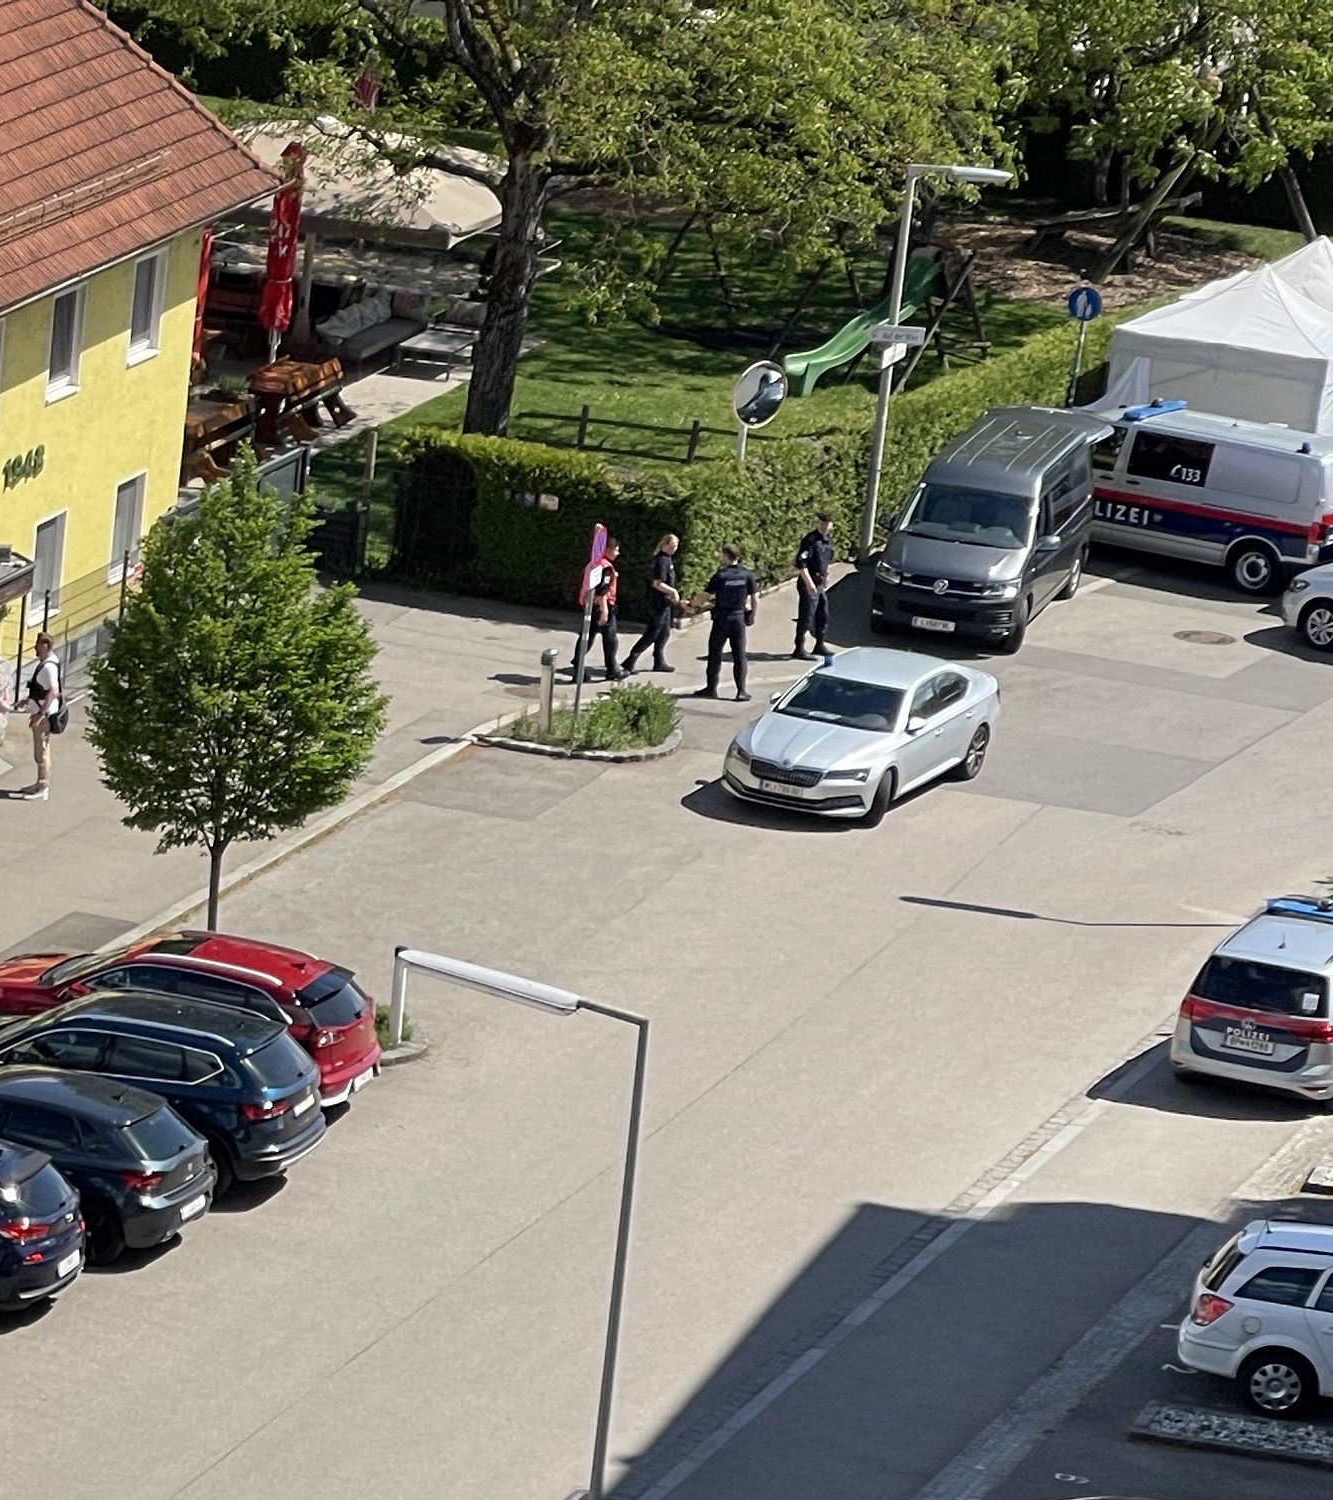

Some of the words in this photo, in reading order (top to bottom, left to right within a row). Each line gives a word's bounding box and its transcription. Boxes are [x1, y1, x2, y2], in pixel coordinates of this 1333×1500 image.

[1181, 467, 1201, 482] 133
[1094, 500, 1149, 525] LIZEI
[1227, 1026, 1270, 1041] POLIZEI
